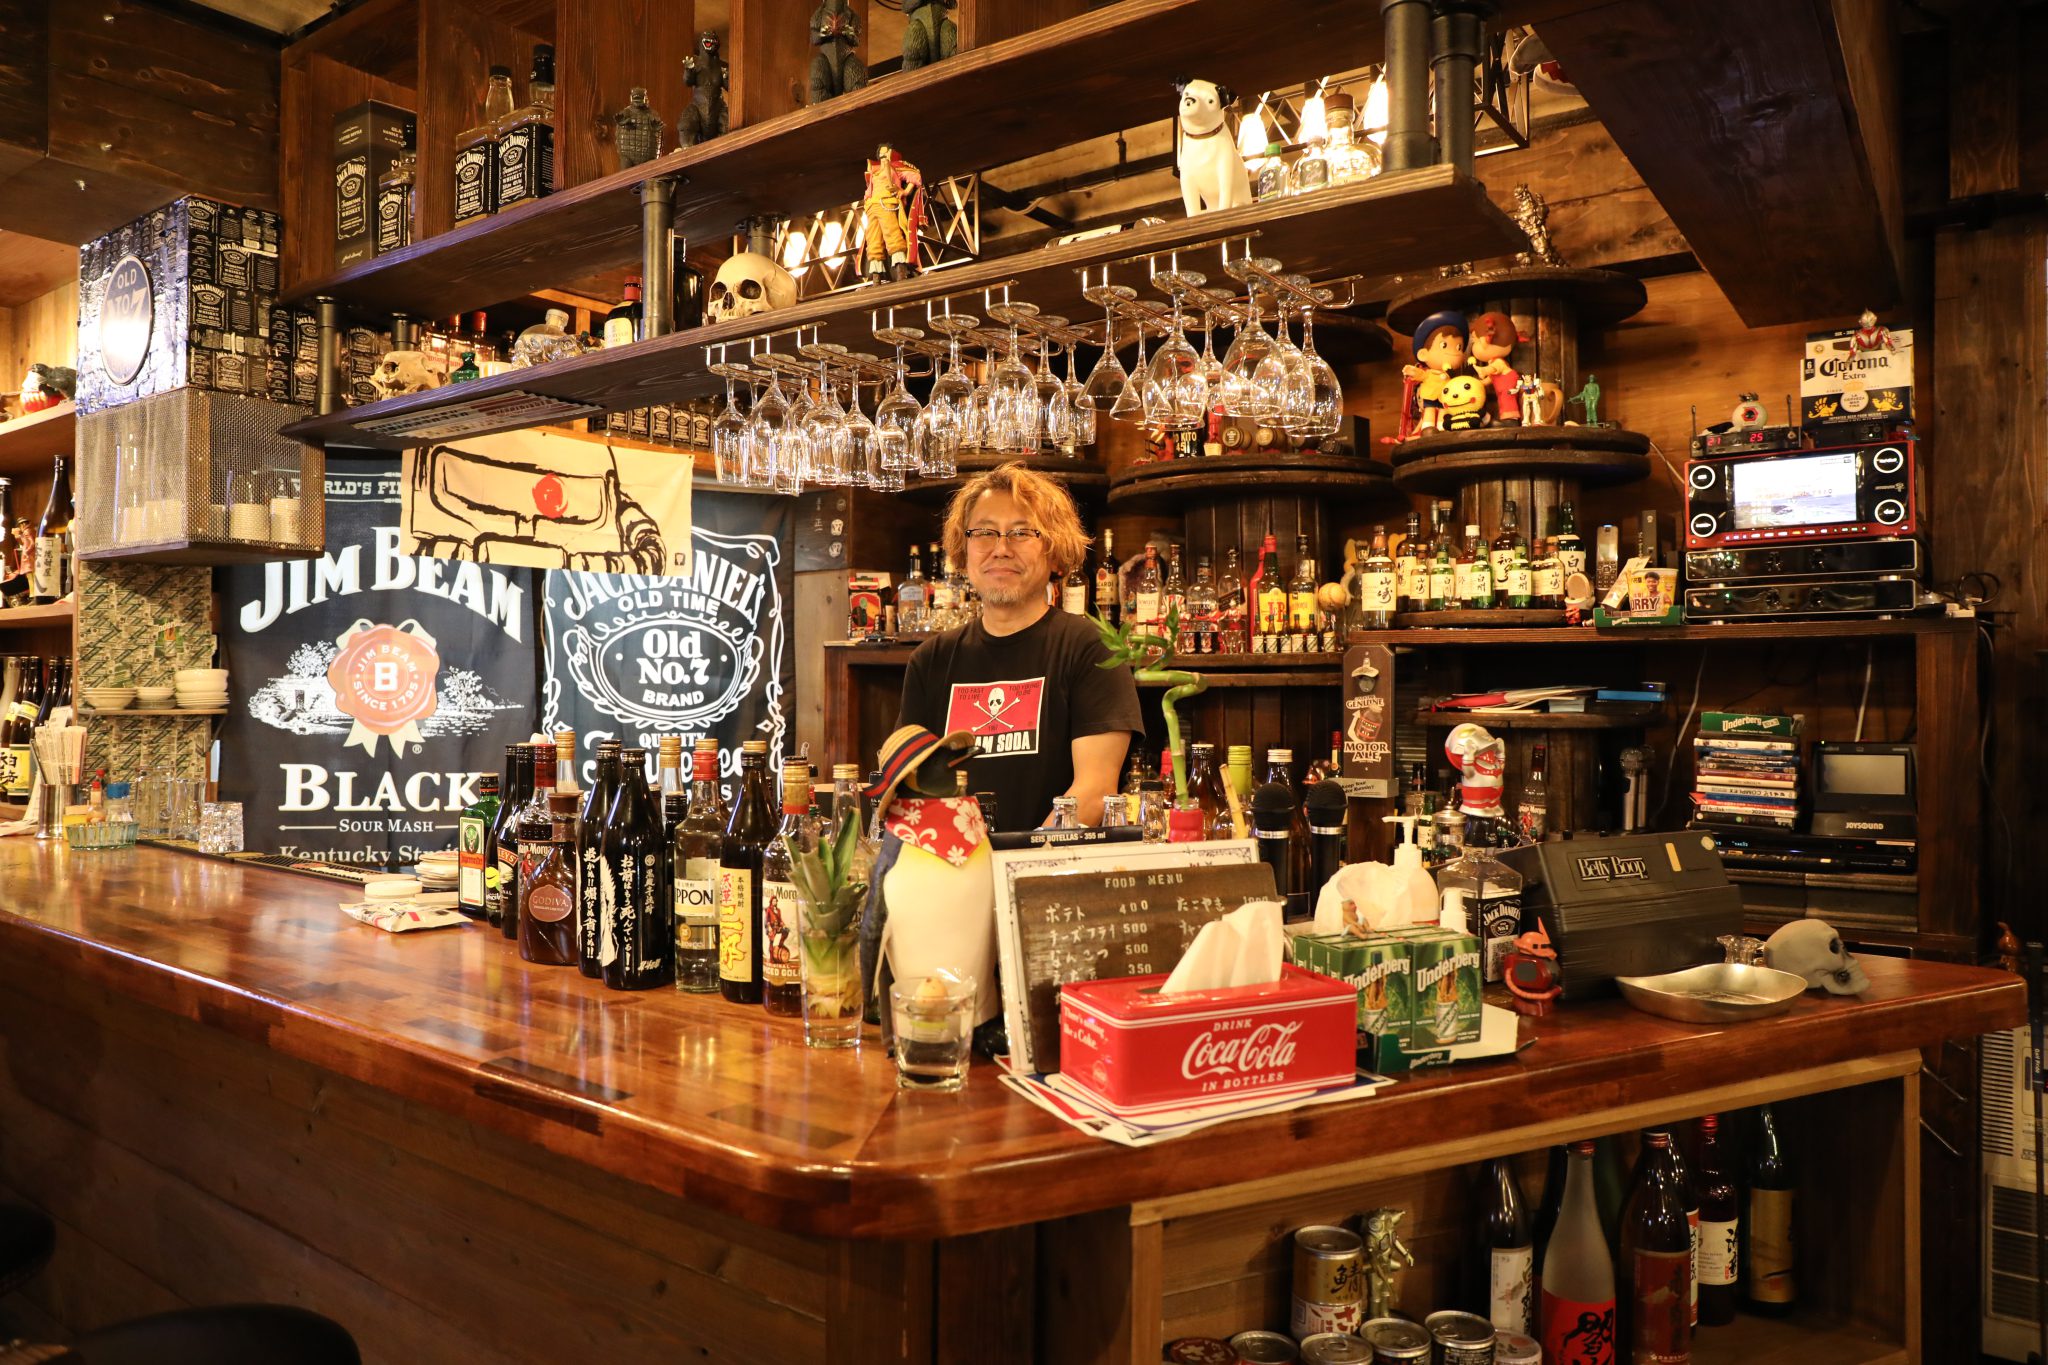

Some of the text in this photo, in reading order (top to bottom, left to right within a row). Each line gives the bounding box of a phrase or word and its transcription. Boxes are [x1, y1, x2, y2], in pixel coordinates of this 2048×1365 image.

[117, 268, 137, 289] OLD
[1819, 355, 1889, 378] Corona
[1842, 372, 1867, 380] Extra
[241, 526, 524, 643] JIM BEAM
[618, 591, 721, 617] OLD TIME
[642, 628, 703, 659] Old
[358, 644, 417, 673] JIM BEAM
[374, 662, 398, 691] B
[636, 658, 711, 685] No.7
[353, 681, 419, 711] SINCE 1795
[642, 689, 705, 707] BRAND
[1722, 716, 1762, 732] Underberg
[996, 731, 1031, 752] SODA
[1344, 742, 1387, 752] MOTOR
[1354, 751, 1379, 760] ALE
[278, 763, 482, 812] BLACK
[339, 818, 434, 833] SOUR MASH
[1845, 822, 1884, 830] JOYSOUND
[1030, 834, 1046, 844] SEIS
[1084, 831, 1097, 840] 355
[1097, 831, 1106, 839] ml
[279, 846, 392, 867] Kentucky
[1577, 856, 1646, 881] Betty Boop
[1105, 873, 1184, 888] FOOD MENU
[1045, 900, 1149, 923] ポテト 400
[1483, 908, 1500, 926] JACK
[1123, 923, 1148, 934] 500
[1125, 943, 1149, 956] 500
[1128, 963, 1152, 975] 350
[1416, 951, 1481, 993] Underberg
[1213, 1018, 1252, 1032] DRINK
[1181, 1021, 1304, 1080] Coca-Cola
[1202, 1071, 1284, 1093] IN BOTTLES
